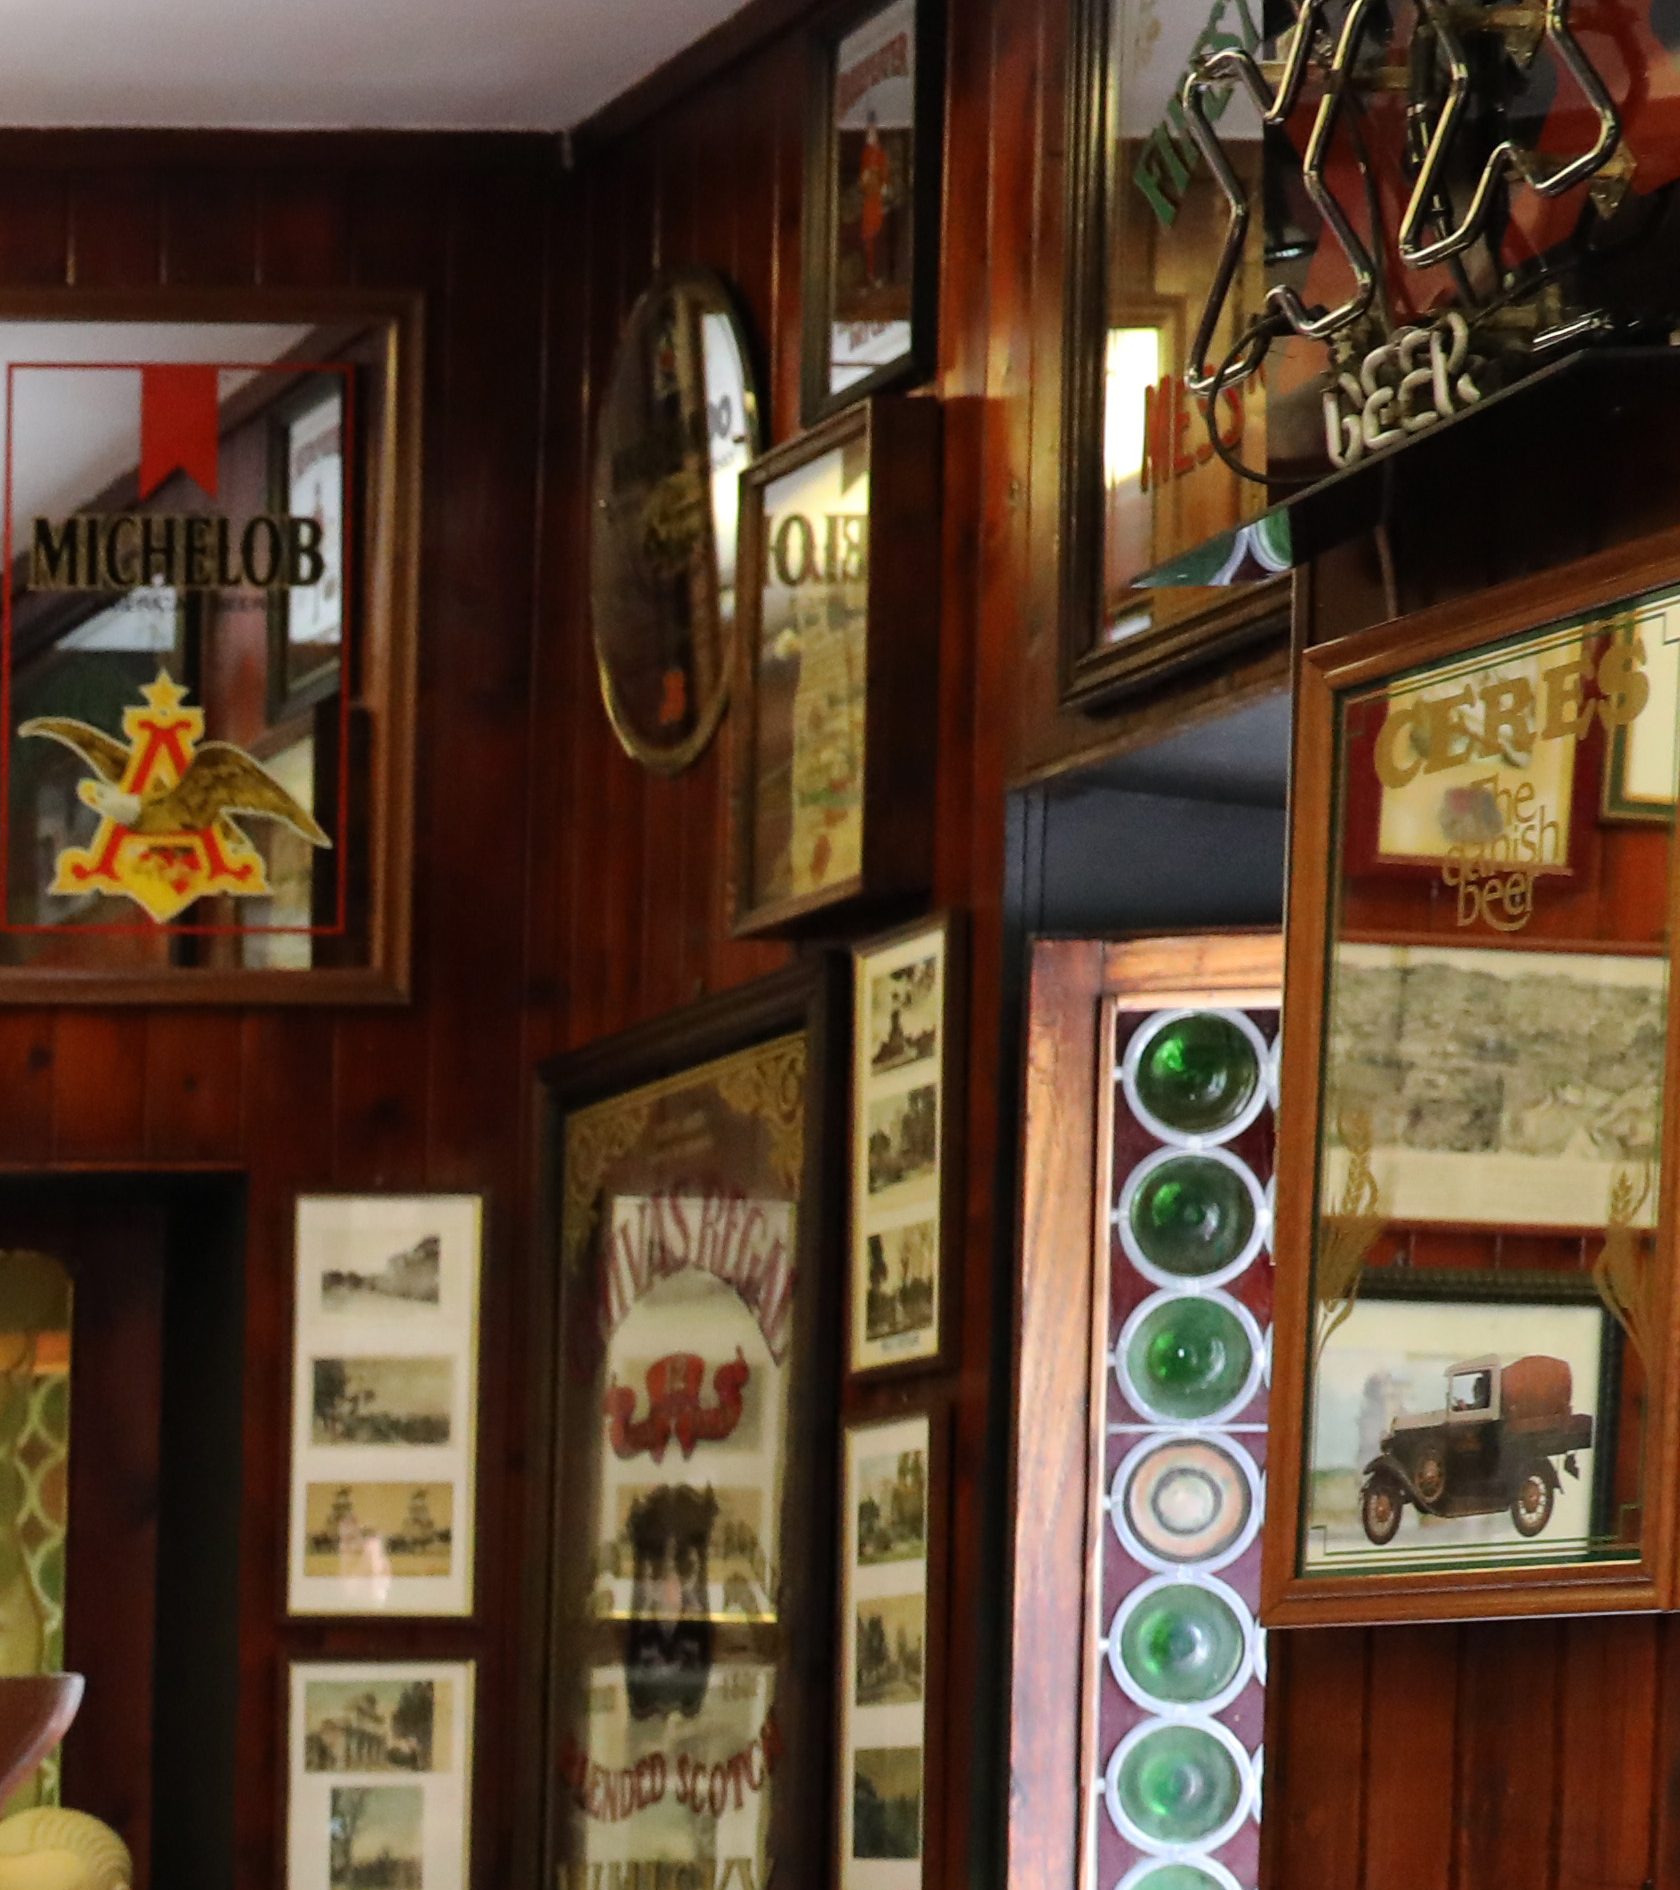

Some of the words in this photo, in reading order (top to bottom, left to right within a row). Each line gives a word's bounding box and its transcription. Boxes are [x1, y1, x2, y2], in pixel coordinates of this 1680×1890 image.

[27, 512, 326, 590] MICHELOB
[1373, 632, 1650, 790] CERES
[1456, 871, 1535, 933] beer
